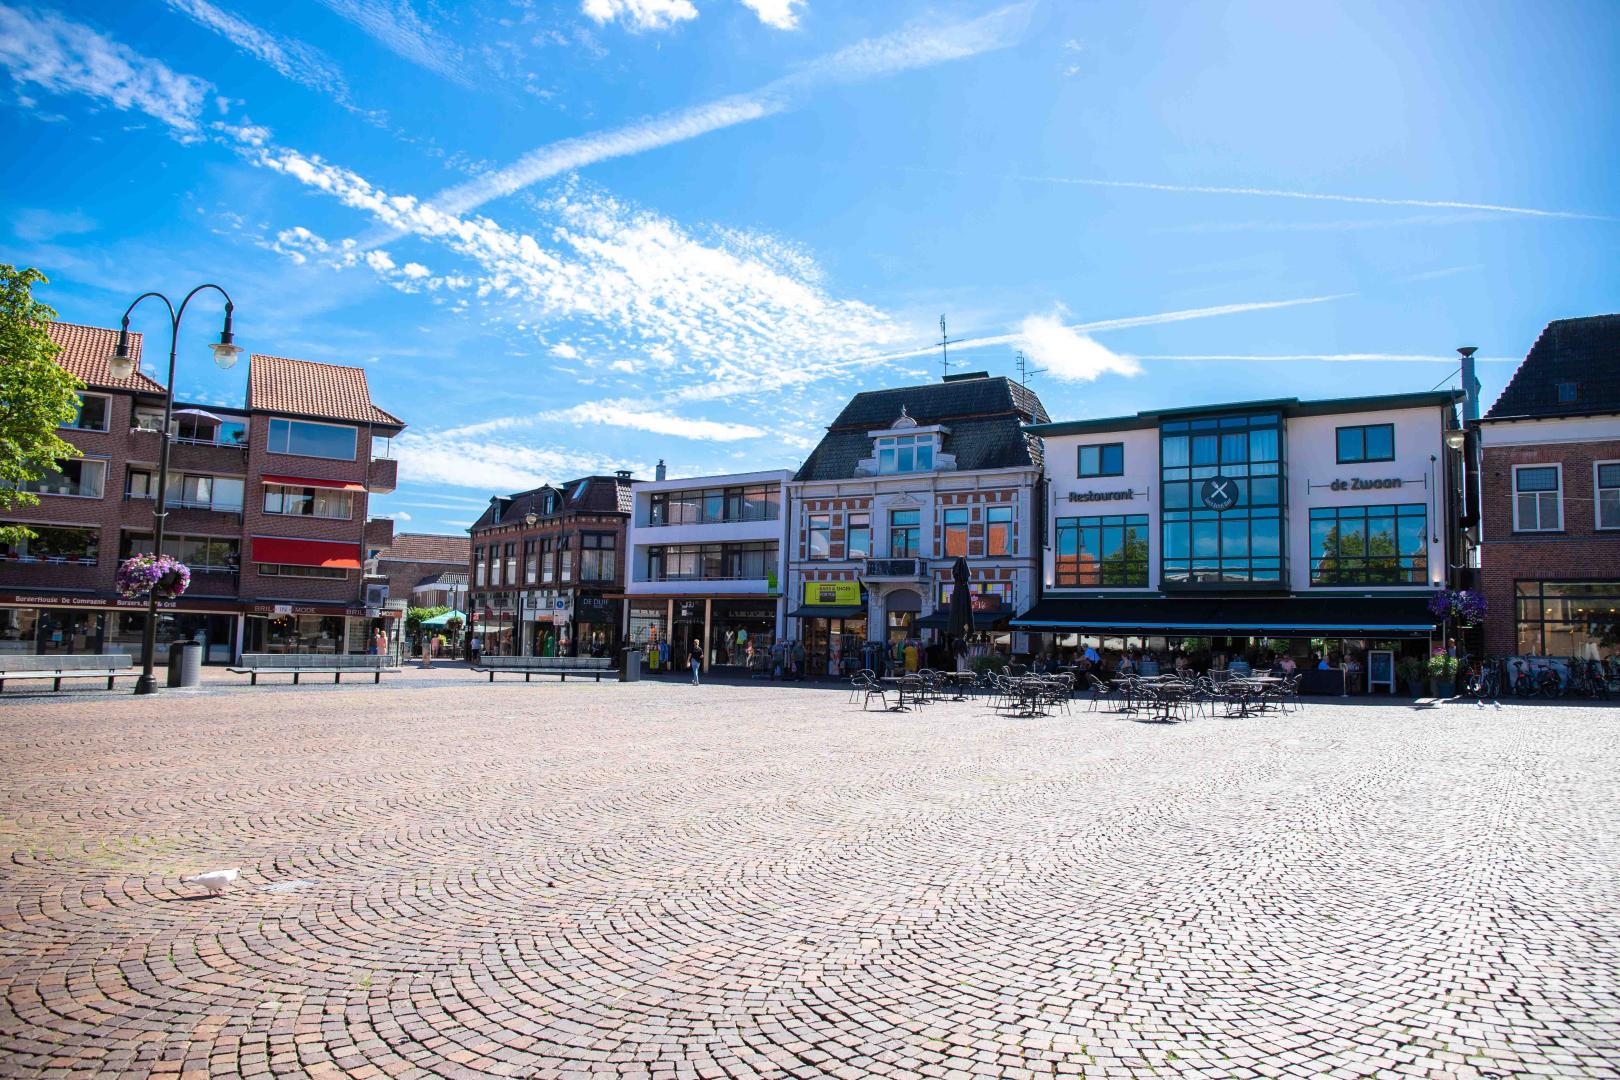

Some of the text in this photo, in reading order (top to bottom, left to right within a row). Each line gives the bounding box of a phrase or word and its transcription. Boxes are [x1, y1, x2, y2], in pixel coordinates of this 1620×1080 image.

[1330, 477, 1402, 492] de Zwaan
[1068, 488, 1134, 503] Restaurant
